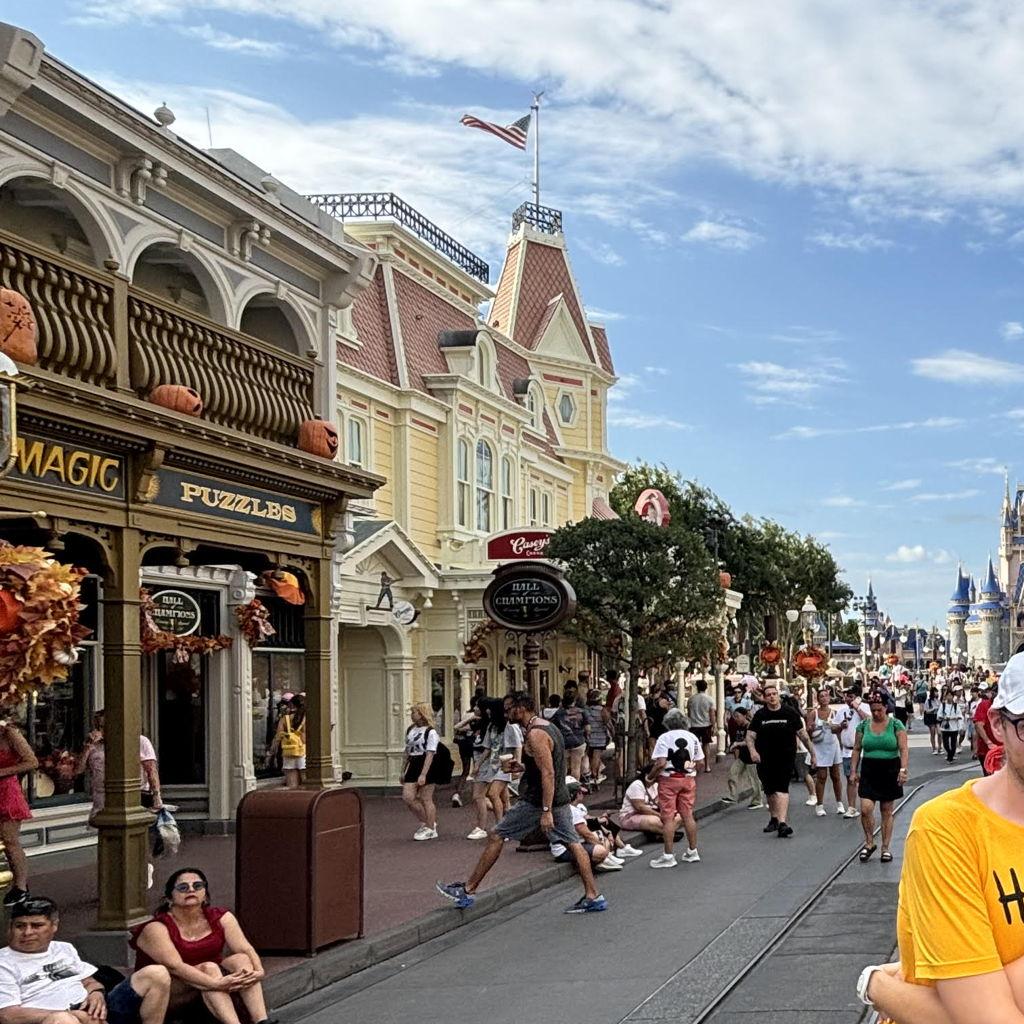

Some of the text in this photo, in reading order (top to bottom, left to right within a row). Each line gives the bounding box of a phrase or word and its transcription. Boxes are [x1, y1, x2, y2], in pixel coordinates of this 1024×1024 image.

[17, 437, 119, 492] MAGIC
[180, 482, 297, 523] PUZZLES
[512, 582, 540, 591] HALL
[495, 595, 558, 605] CHAMPIONS
